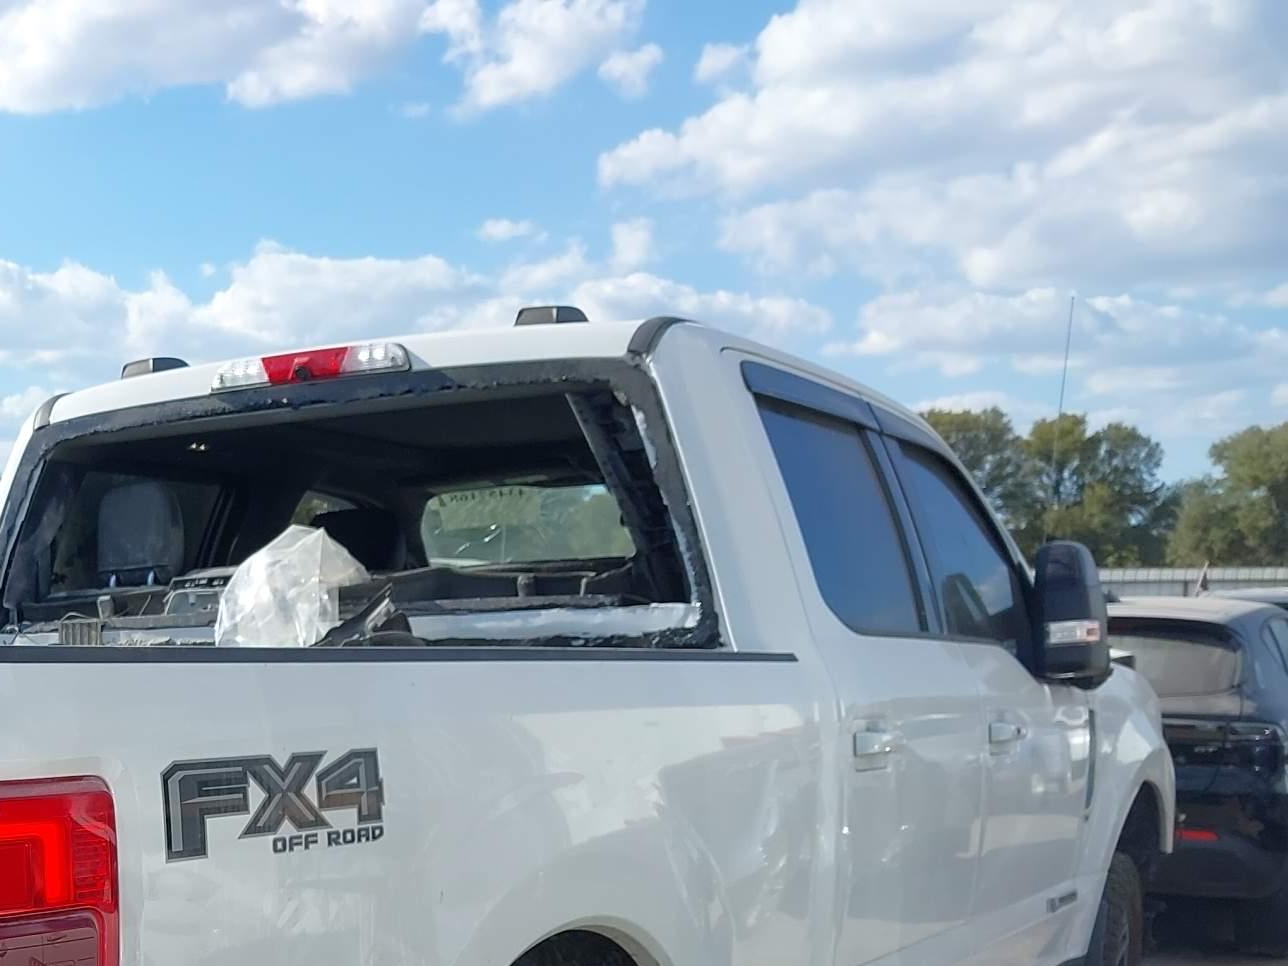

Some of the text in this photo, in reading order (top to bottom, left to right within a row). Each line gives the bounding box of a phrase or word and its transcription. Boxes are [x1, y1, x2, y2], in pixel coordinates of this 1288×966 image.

[161, 748, 384, 864] FX4
[272, 826, 385, 854] OFF ROAD
